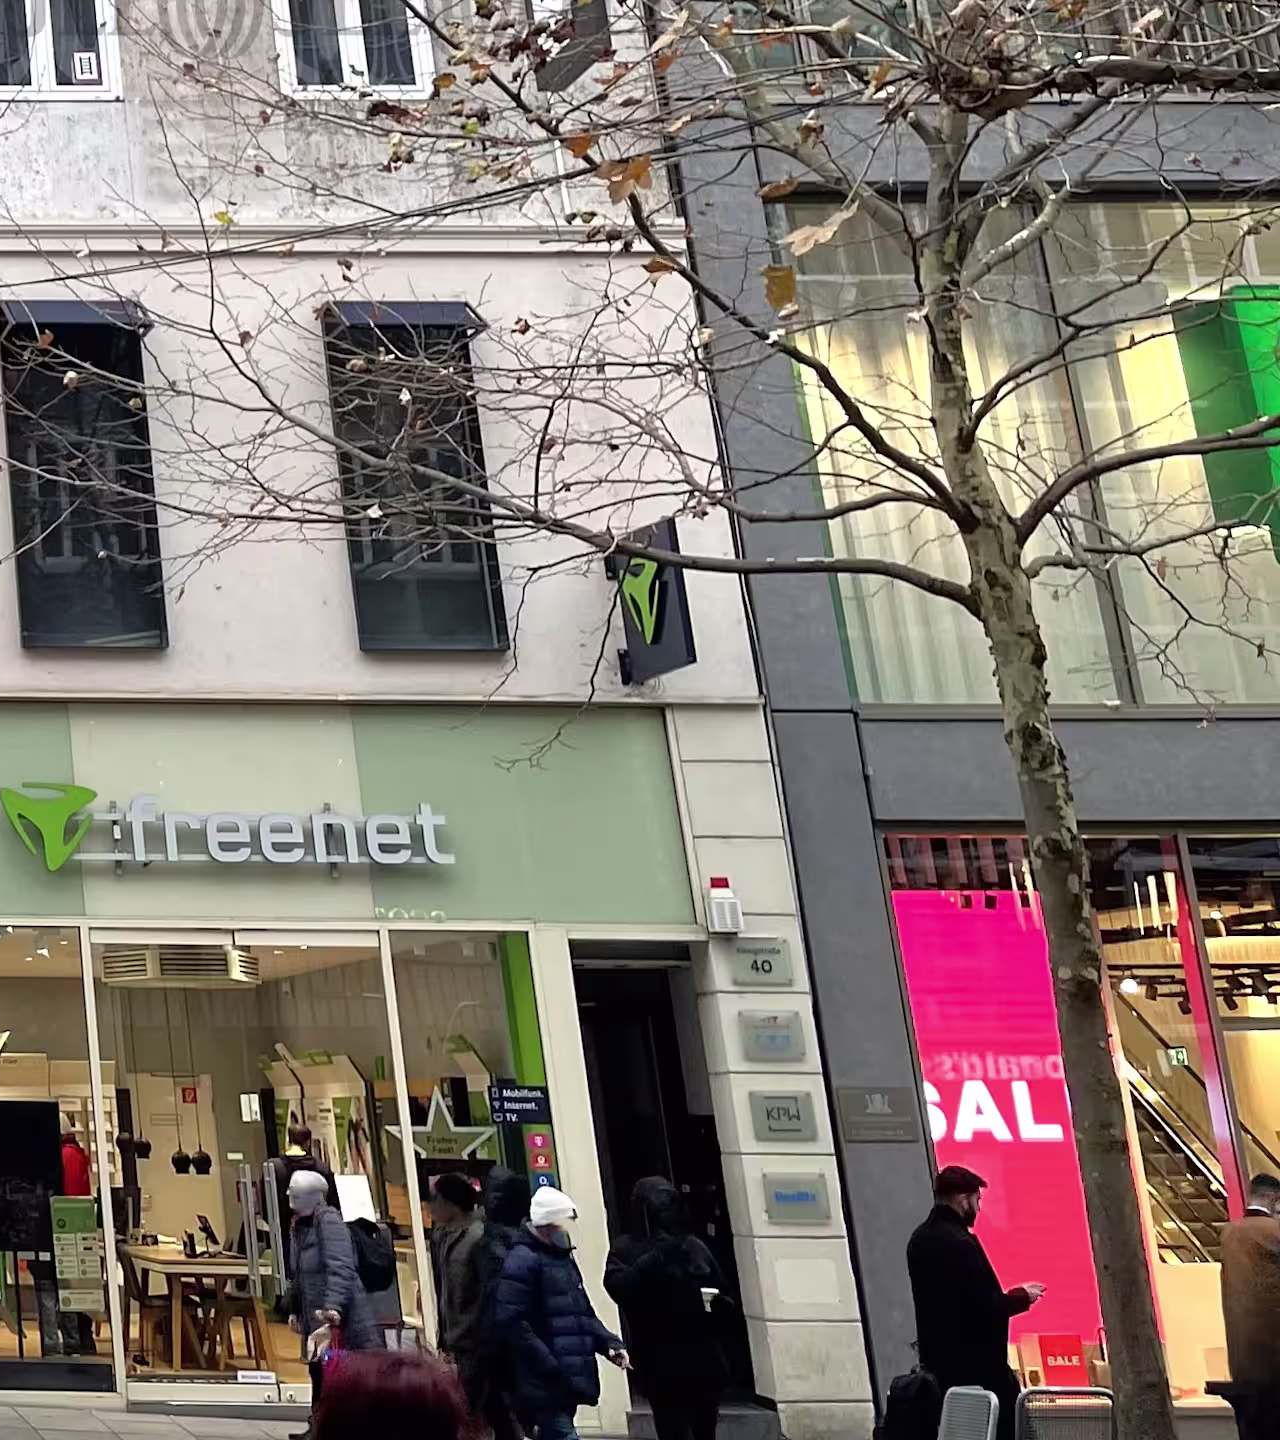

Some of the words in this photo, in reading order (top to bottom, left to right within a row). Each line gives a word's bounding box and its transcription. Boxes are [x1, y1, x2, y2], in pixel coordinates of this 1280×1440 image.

[124, 794, 456, 865] freenet
[751, 959, 772, 973] 40
[1047, 1355, 1081, 1366] SALE
